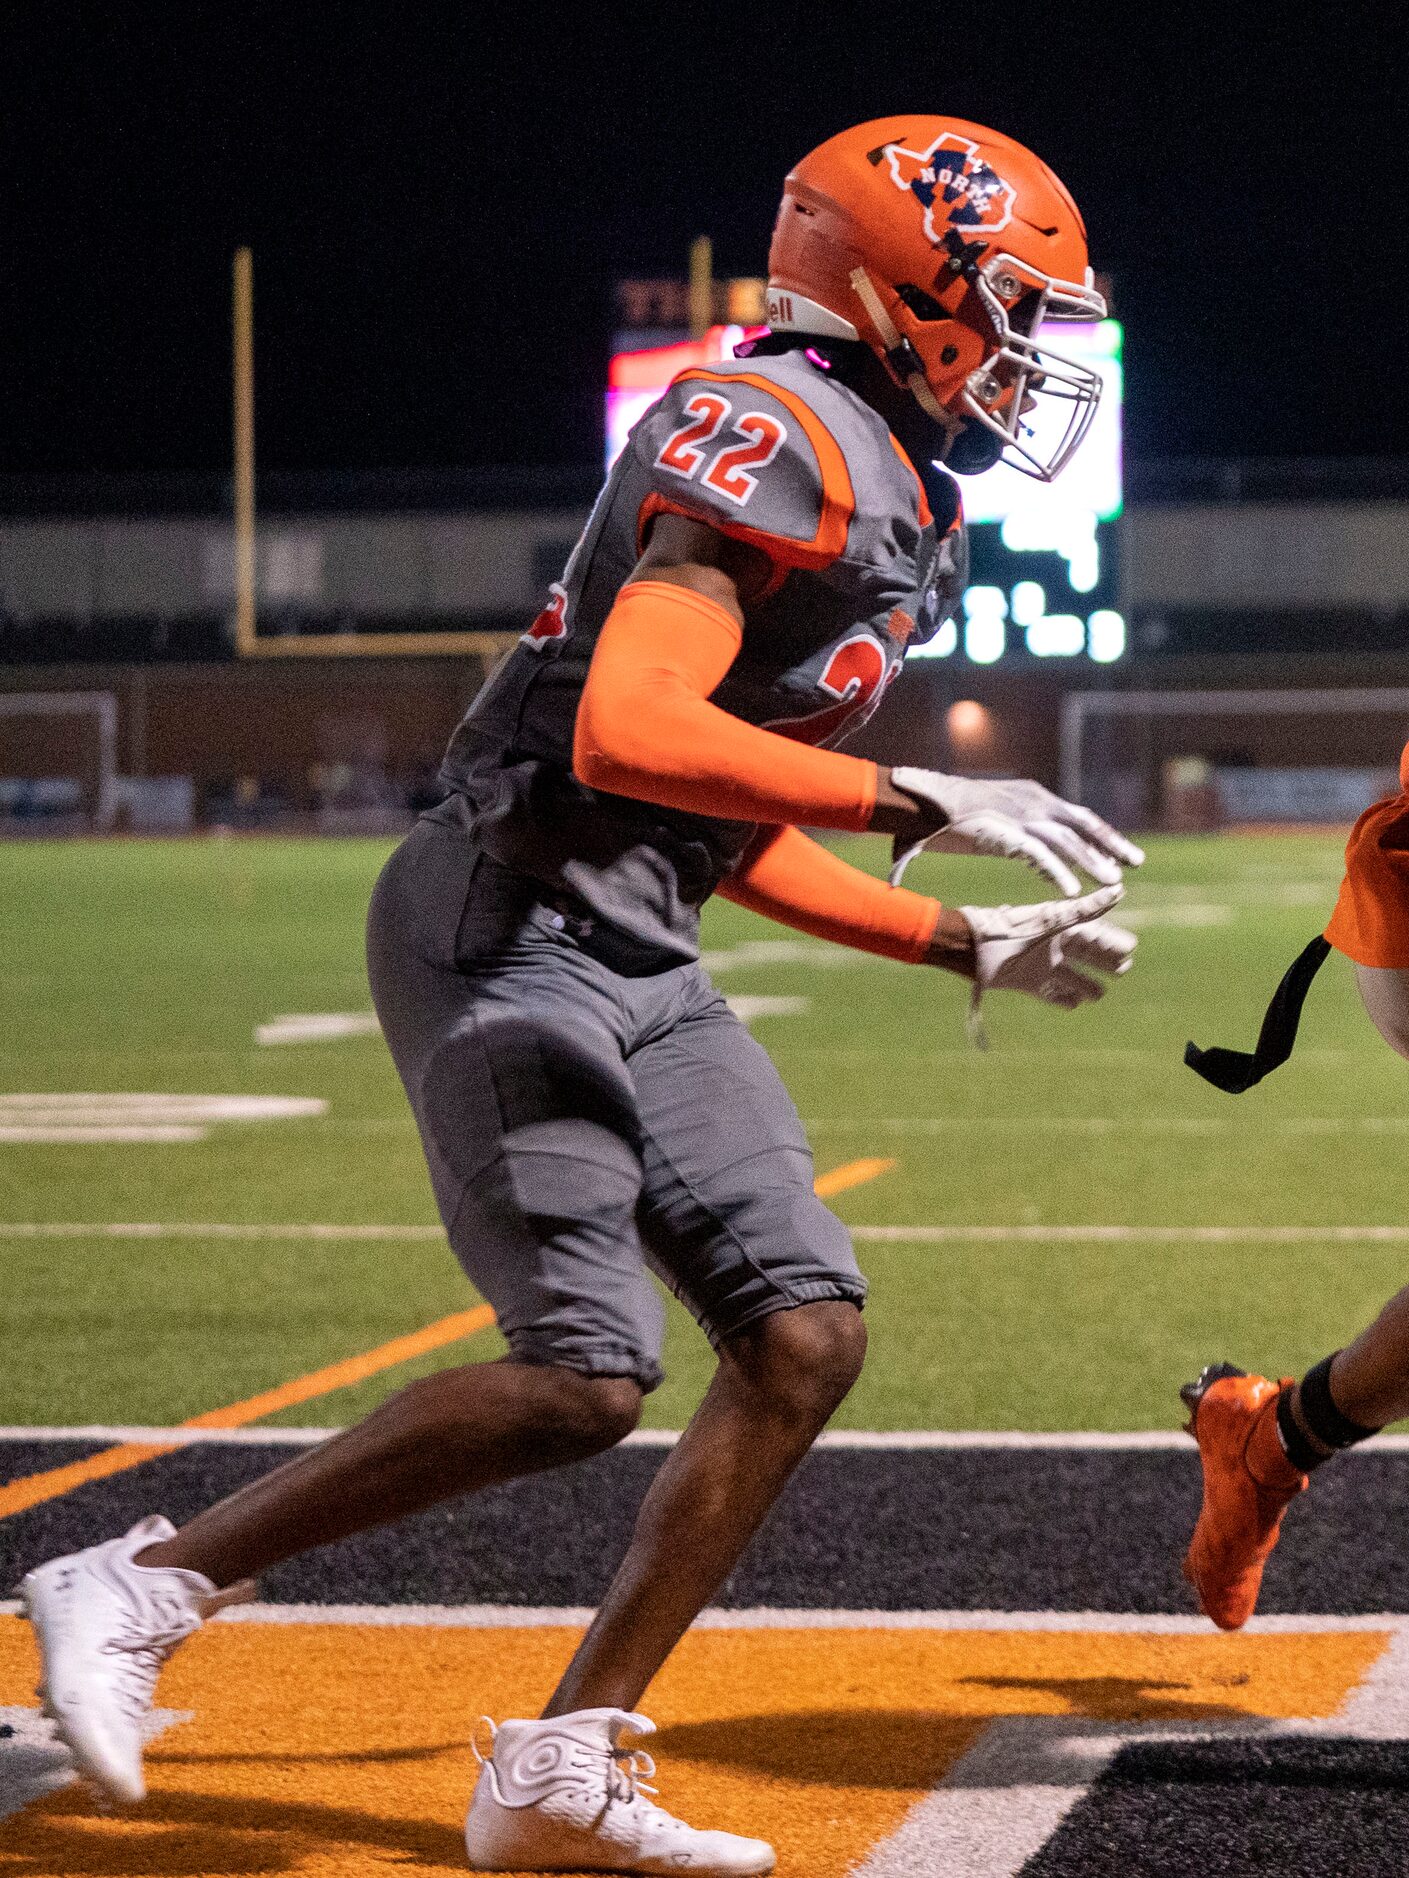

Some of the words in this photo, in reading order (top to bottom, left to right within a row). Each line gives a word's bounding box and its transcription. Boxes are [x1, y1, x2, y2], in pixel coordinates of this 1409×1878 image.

[920, 167, 992, 213] NORTH
[653, 392, 788, 507] 22
[759, 633, 904, 751] 2
